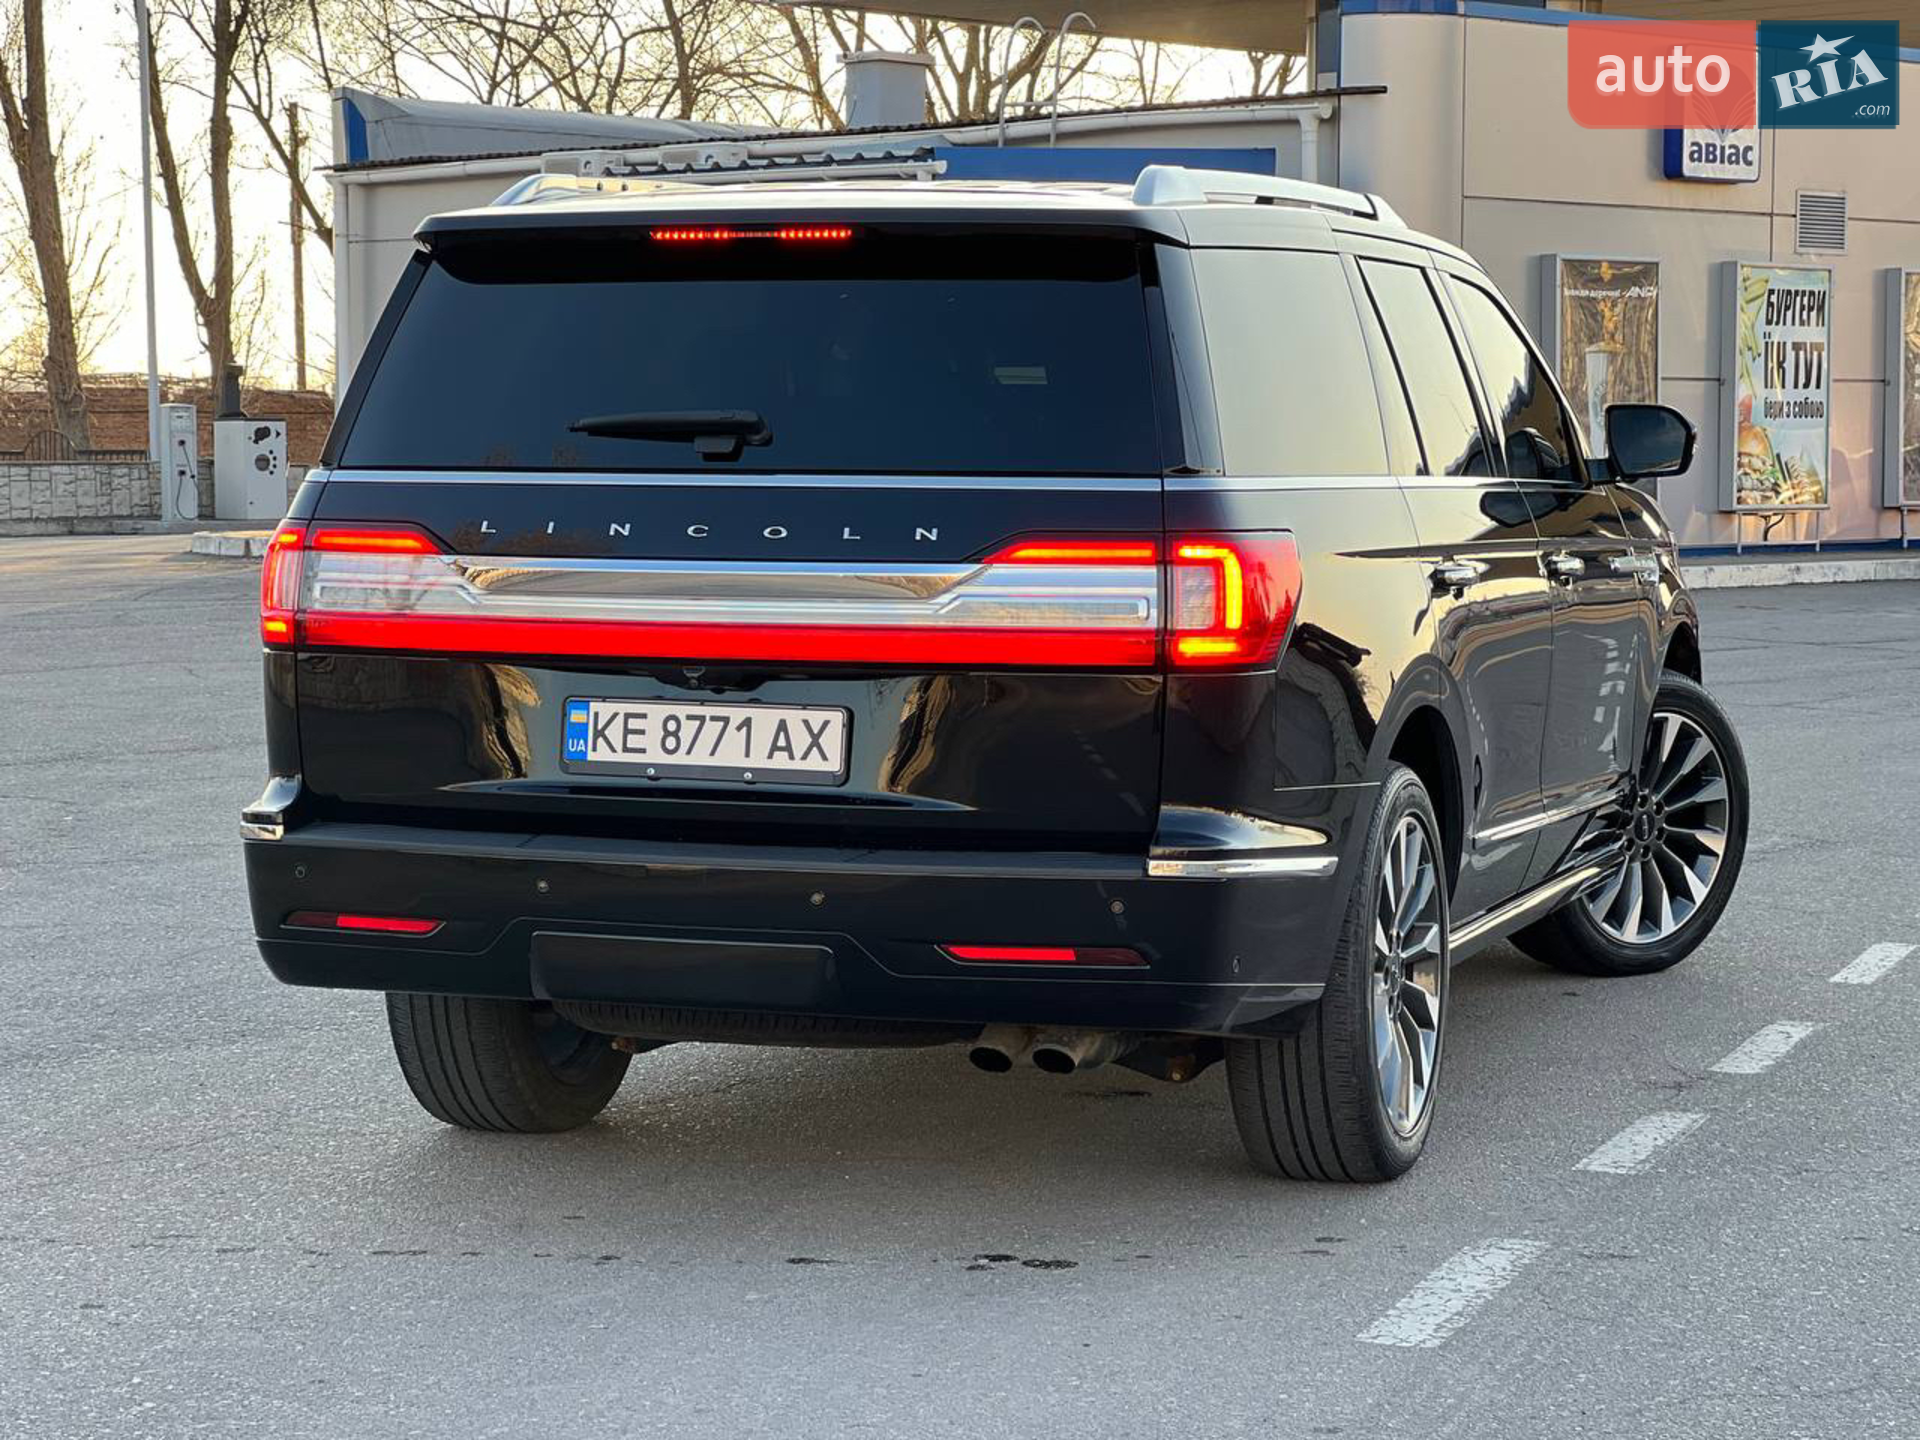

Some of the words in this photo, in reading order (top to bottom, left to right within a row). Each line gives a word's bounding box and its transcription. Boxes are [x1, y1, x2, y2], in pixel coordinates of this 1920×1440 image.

[1765, 288, 1826, 328] БУРГЕРИ
[1792, 341, 1825, 390] ТУТ
[1792, 396, 1825, 419] собою
[480, 519, 939, 542] LINCOLN
[568, 738, 586, 752] UA
[591, 711, 648, 754] KE
[660, 713, 752, 759] 8771
[766, 718, 831, 762] AX
